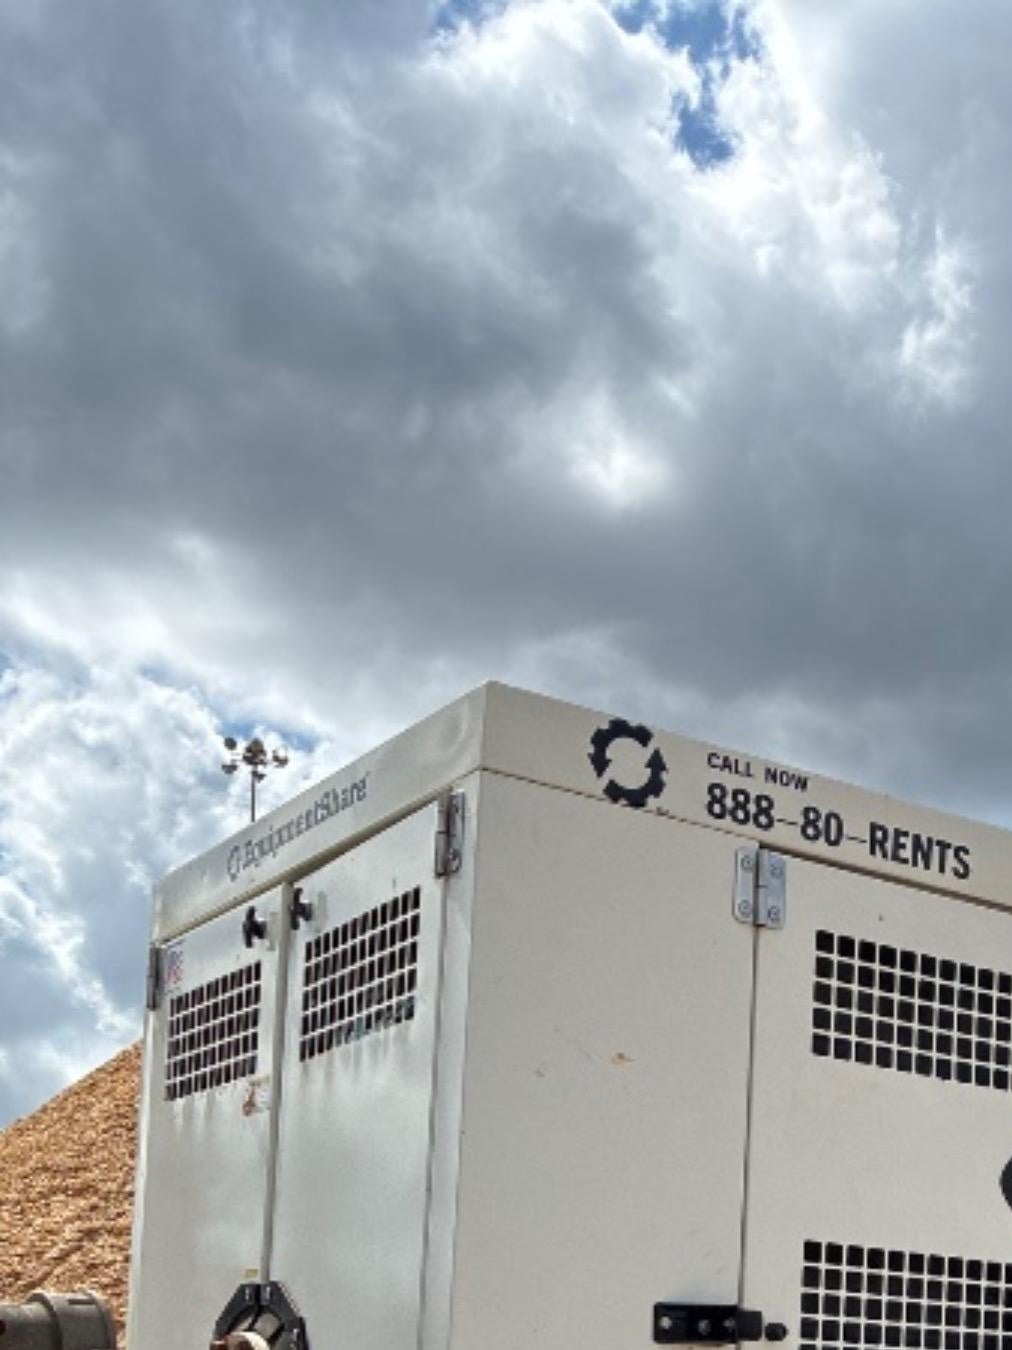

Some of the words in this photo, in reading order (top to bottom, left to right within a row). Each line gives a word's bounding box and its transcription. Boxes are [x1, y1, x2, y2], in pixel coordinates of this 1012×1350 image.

[706, 752, 754, 778] CALL
[764, 766, 809, 792] NOW
[705, 782, 971, 879] 888-80-RENTS
